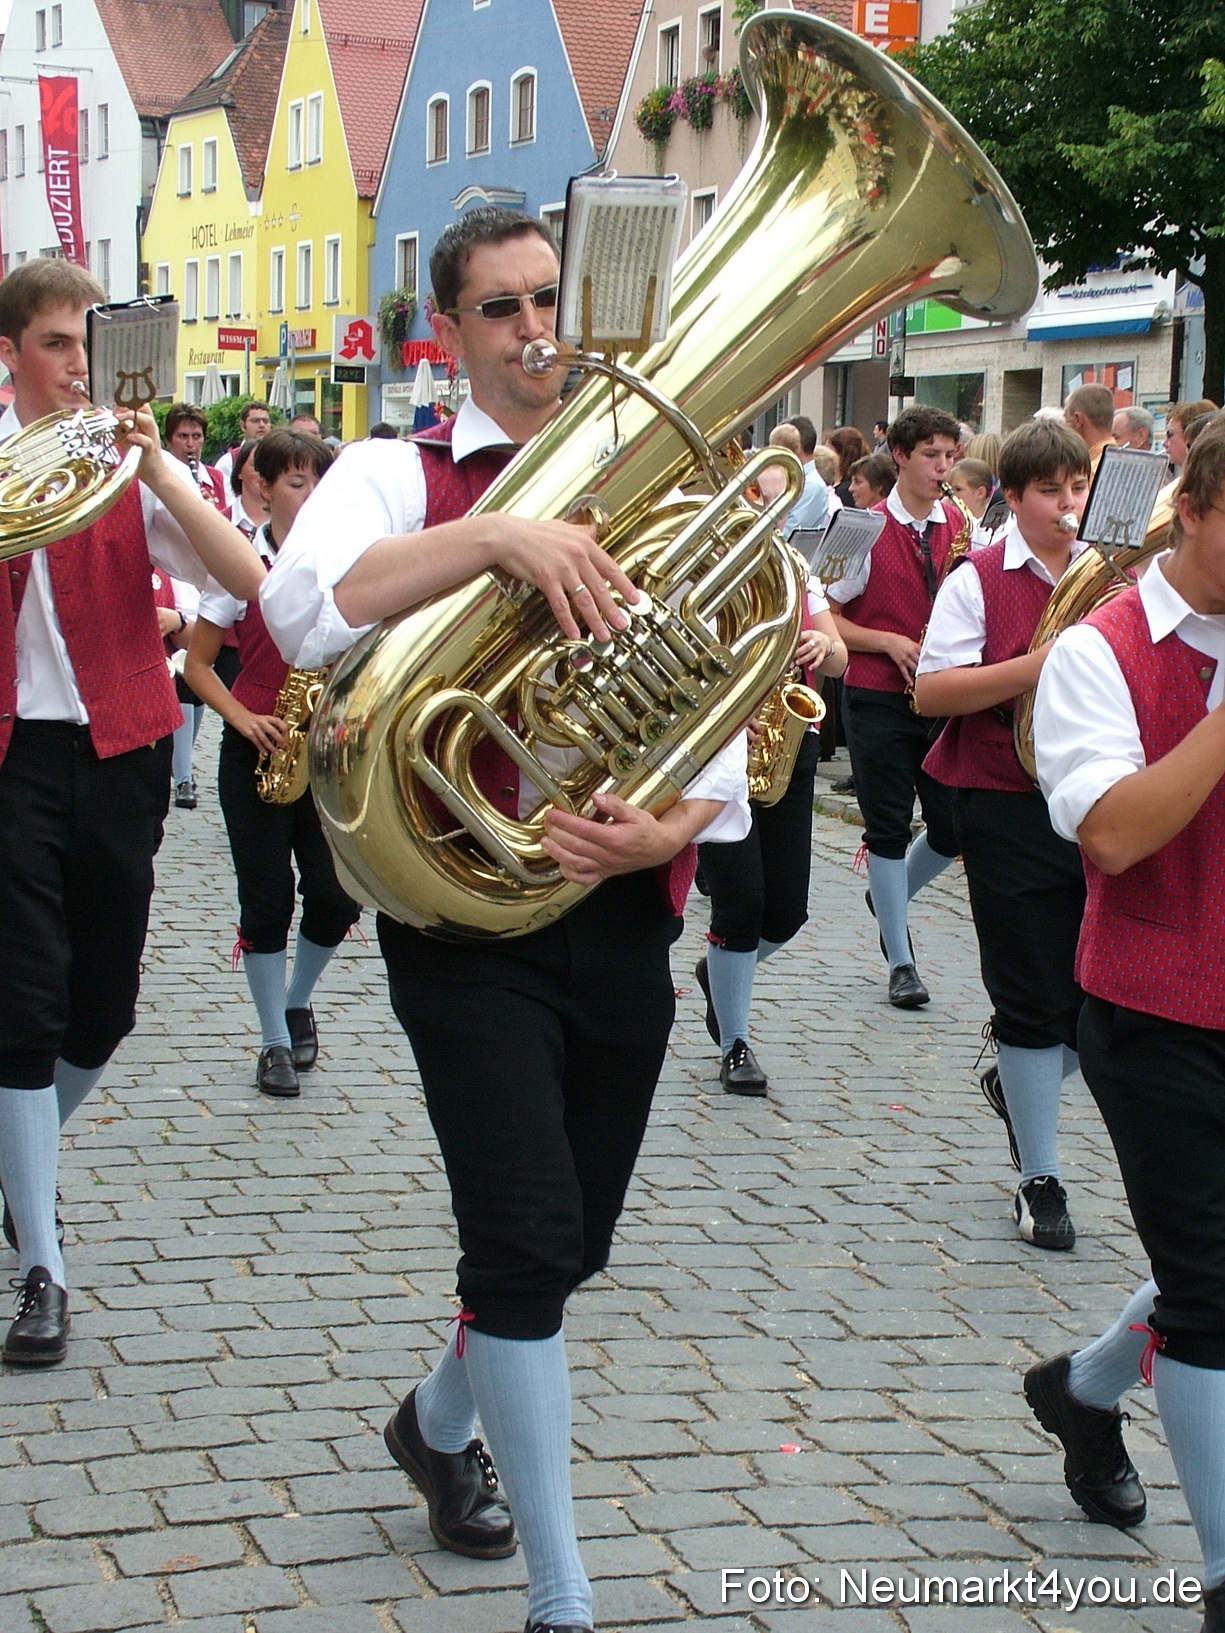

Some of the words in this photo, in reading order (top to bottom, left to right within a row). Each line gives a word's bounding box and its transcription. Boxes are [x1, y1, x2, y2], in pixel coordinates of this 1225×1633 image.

[47, 144, 76, 263] DUZIERT
[191, 223, 218, 249] HOTEL
[219, 334, 256, 345] WISSMAH
[188, 347, 225, 366] Restaurant
